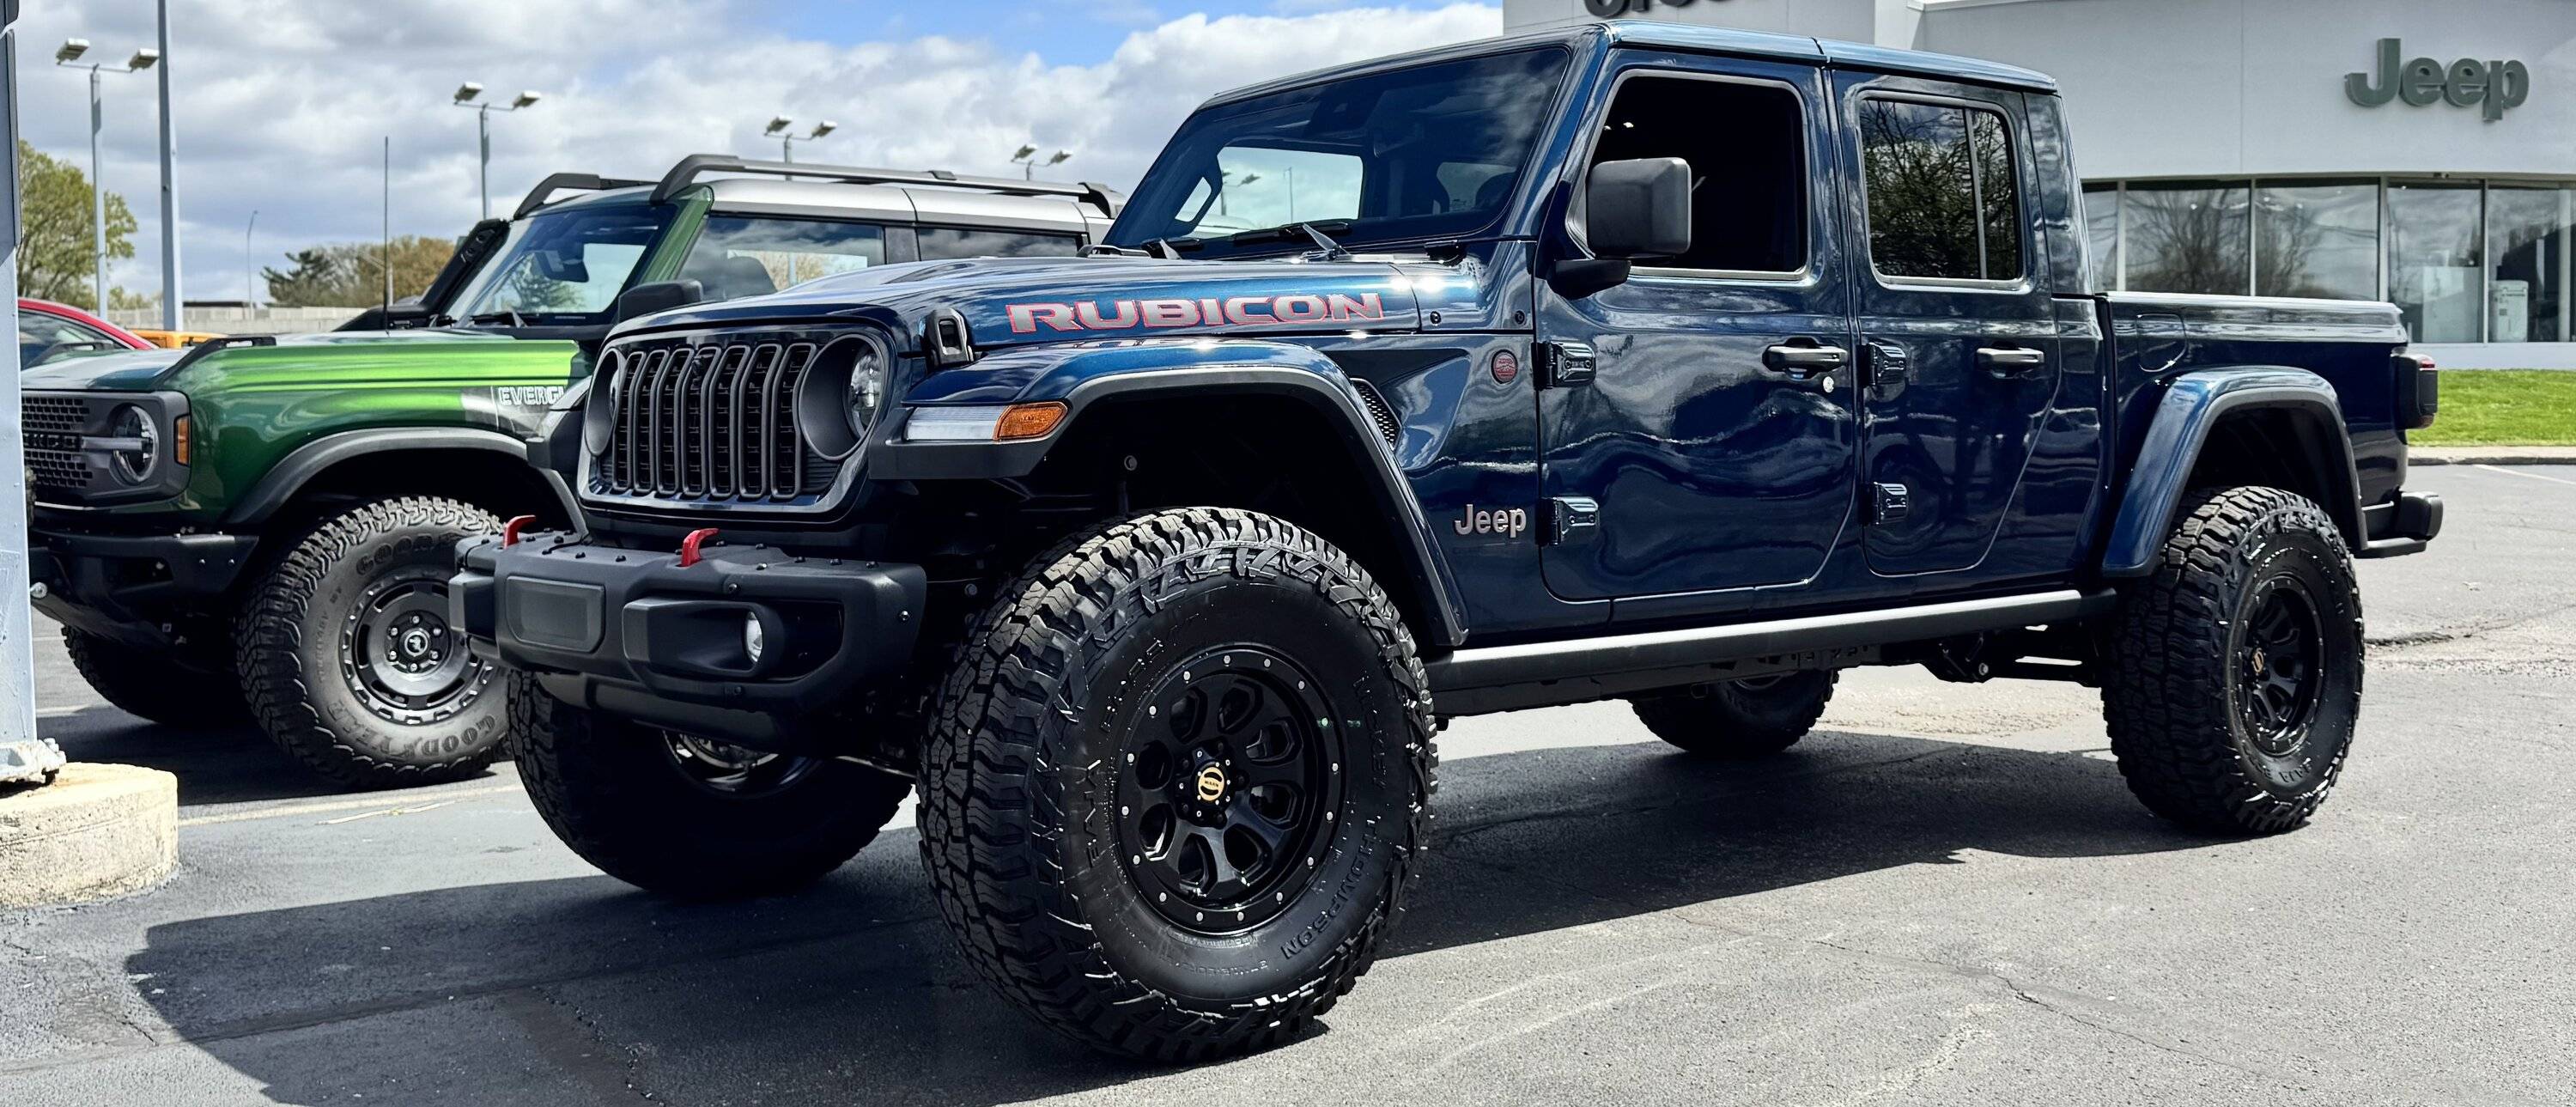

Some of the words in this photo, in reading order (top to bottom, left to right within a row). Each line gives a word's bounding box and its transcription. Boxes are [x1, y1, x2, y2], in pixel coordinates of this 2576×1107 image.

[2344, 38, 2529, 122] Jeep
[1005, 293, 1385, 332] RUBICON
[498, 386, 564, 405] EVERG
[1454, 503, 1527, 538] Jeep
